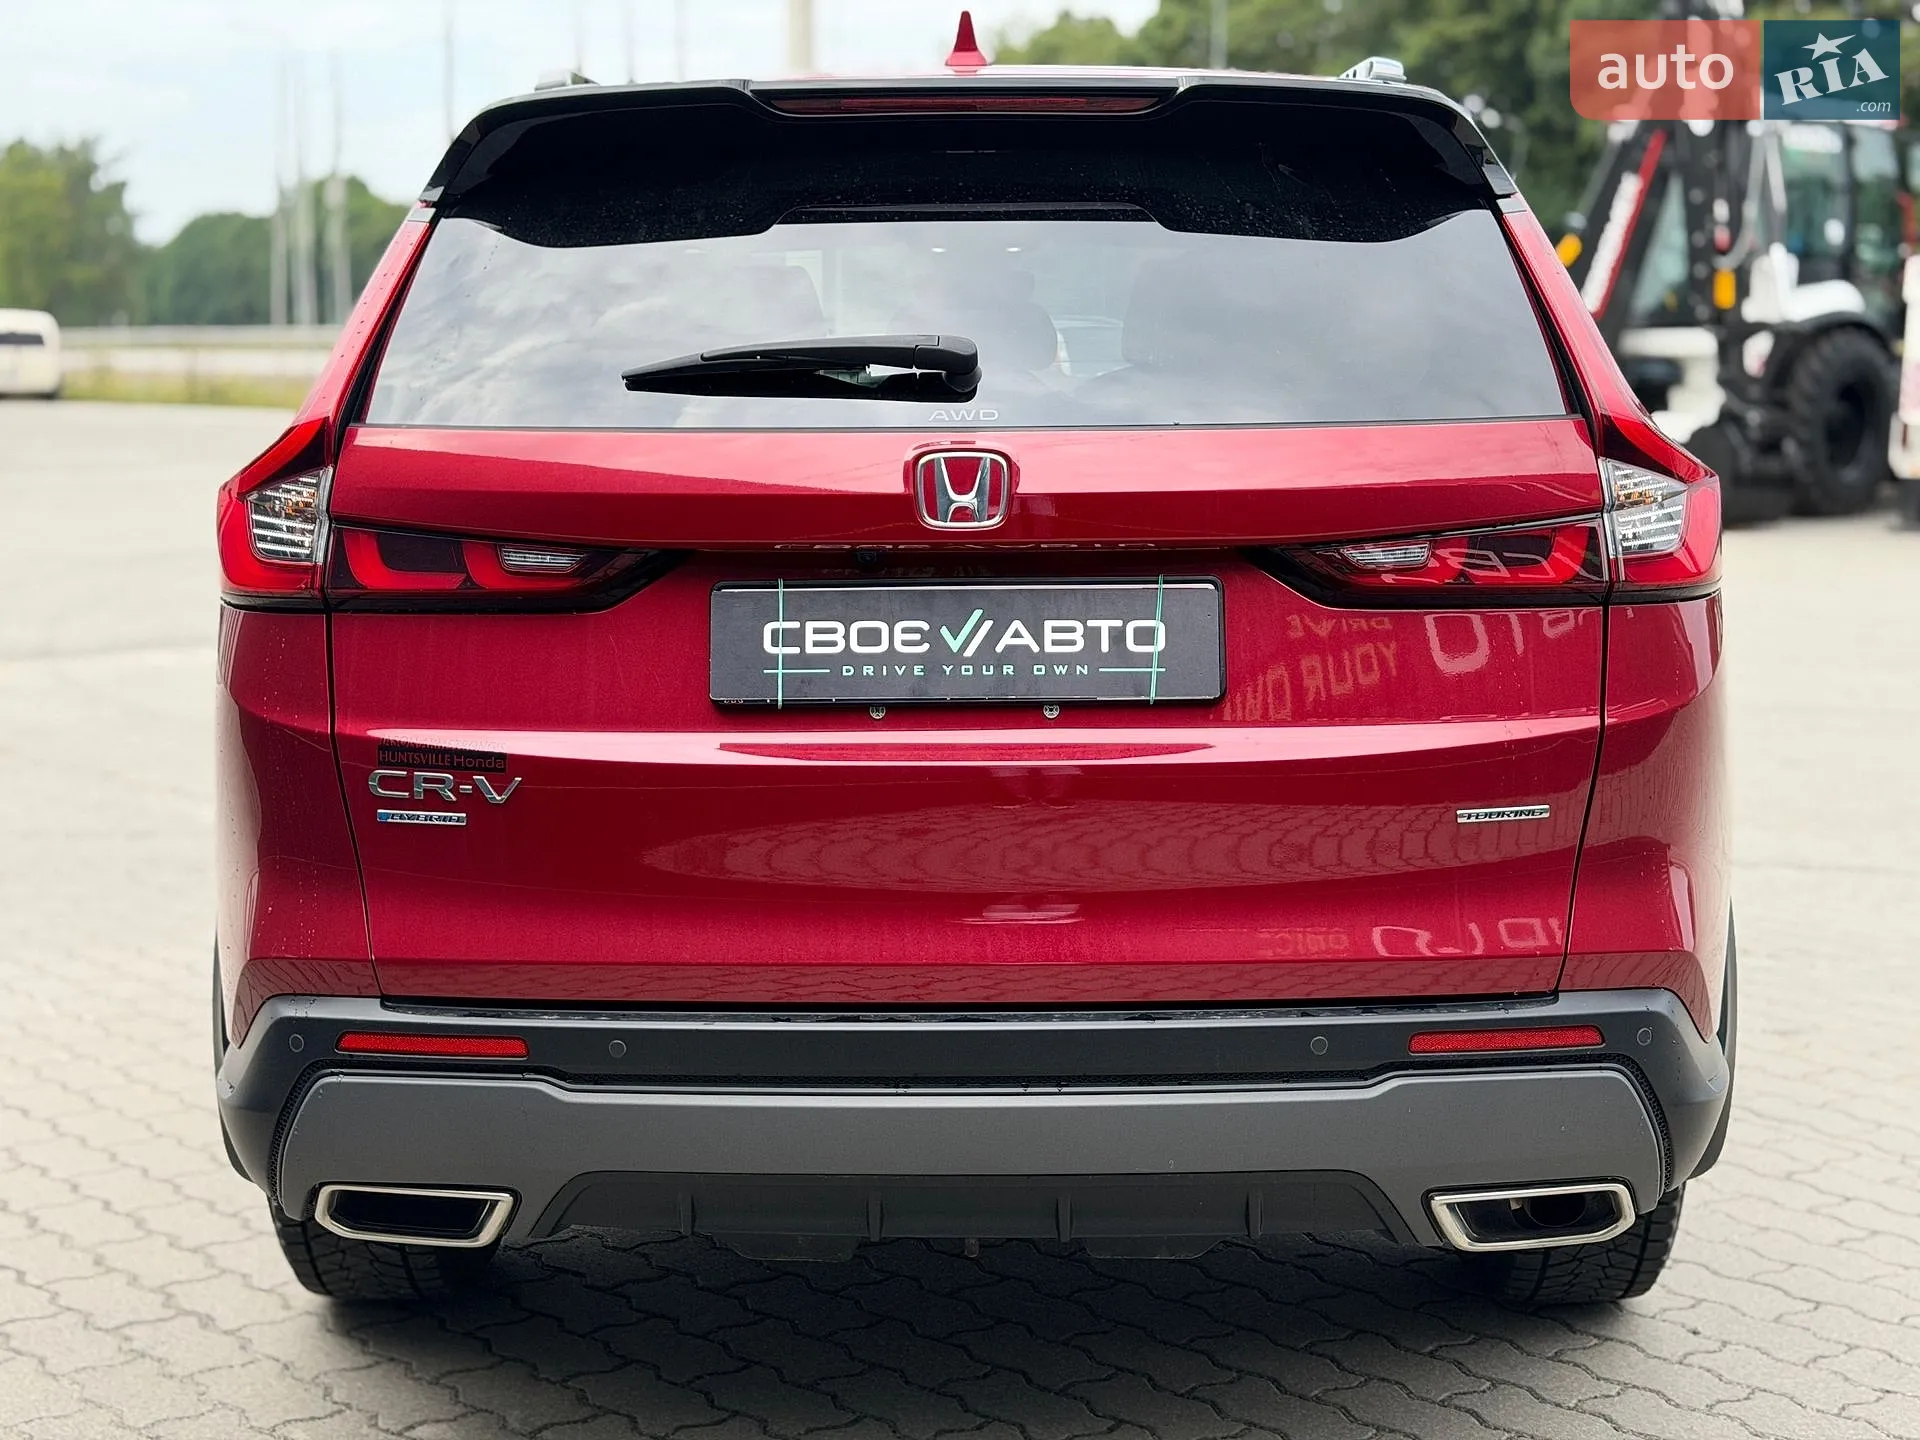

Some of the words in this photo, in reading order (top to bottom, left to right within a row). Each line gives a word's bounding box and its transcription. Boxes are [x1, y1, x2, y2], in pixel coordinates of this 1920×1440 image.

[928, 409, 999, 421] AWD
[763, 619, 931, 655] СВОЕ
[994, 618, 1166, 653] АВТО
[842, 664, 926, 676] DRIVE
[942, 664, 1015, 676] YOUR
[1033, 663, 1089, 675] OWN
[379, 749, 450, 766] HUNTSVILLE
[453, 755, 505, 769] Honda
[368, 769, 523, 804] CR-V
[1462, 808, 1547, 820] TOURING
